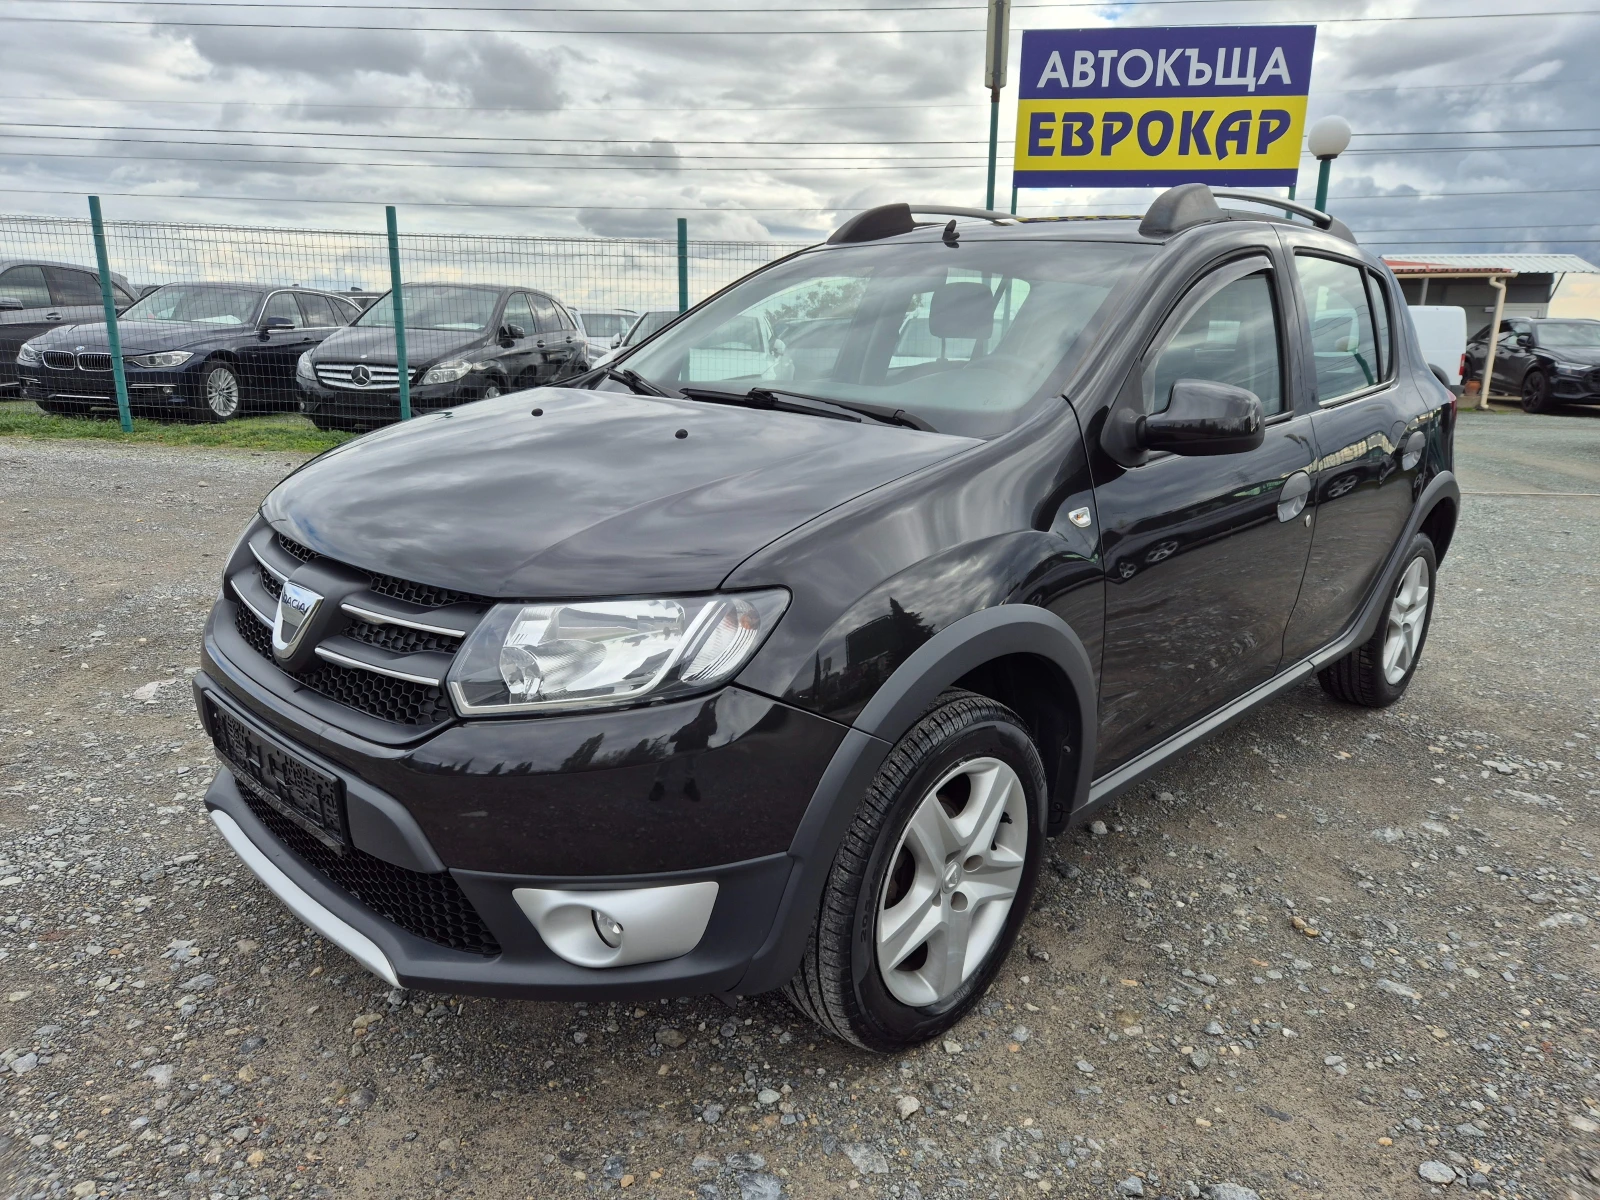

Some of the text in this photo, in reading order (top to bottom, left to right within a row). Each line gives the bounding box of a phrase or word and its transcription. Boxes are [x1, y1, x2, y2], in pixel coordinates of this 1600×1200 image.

[1037, 47, 1291, 91] АВТОКЪЩА
[1029, 111, 1290, 159] ЕВРОКАР
[282, 593, 306, 612] DACIA
